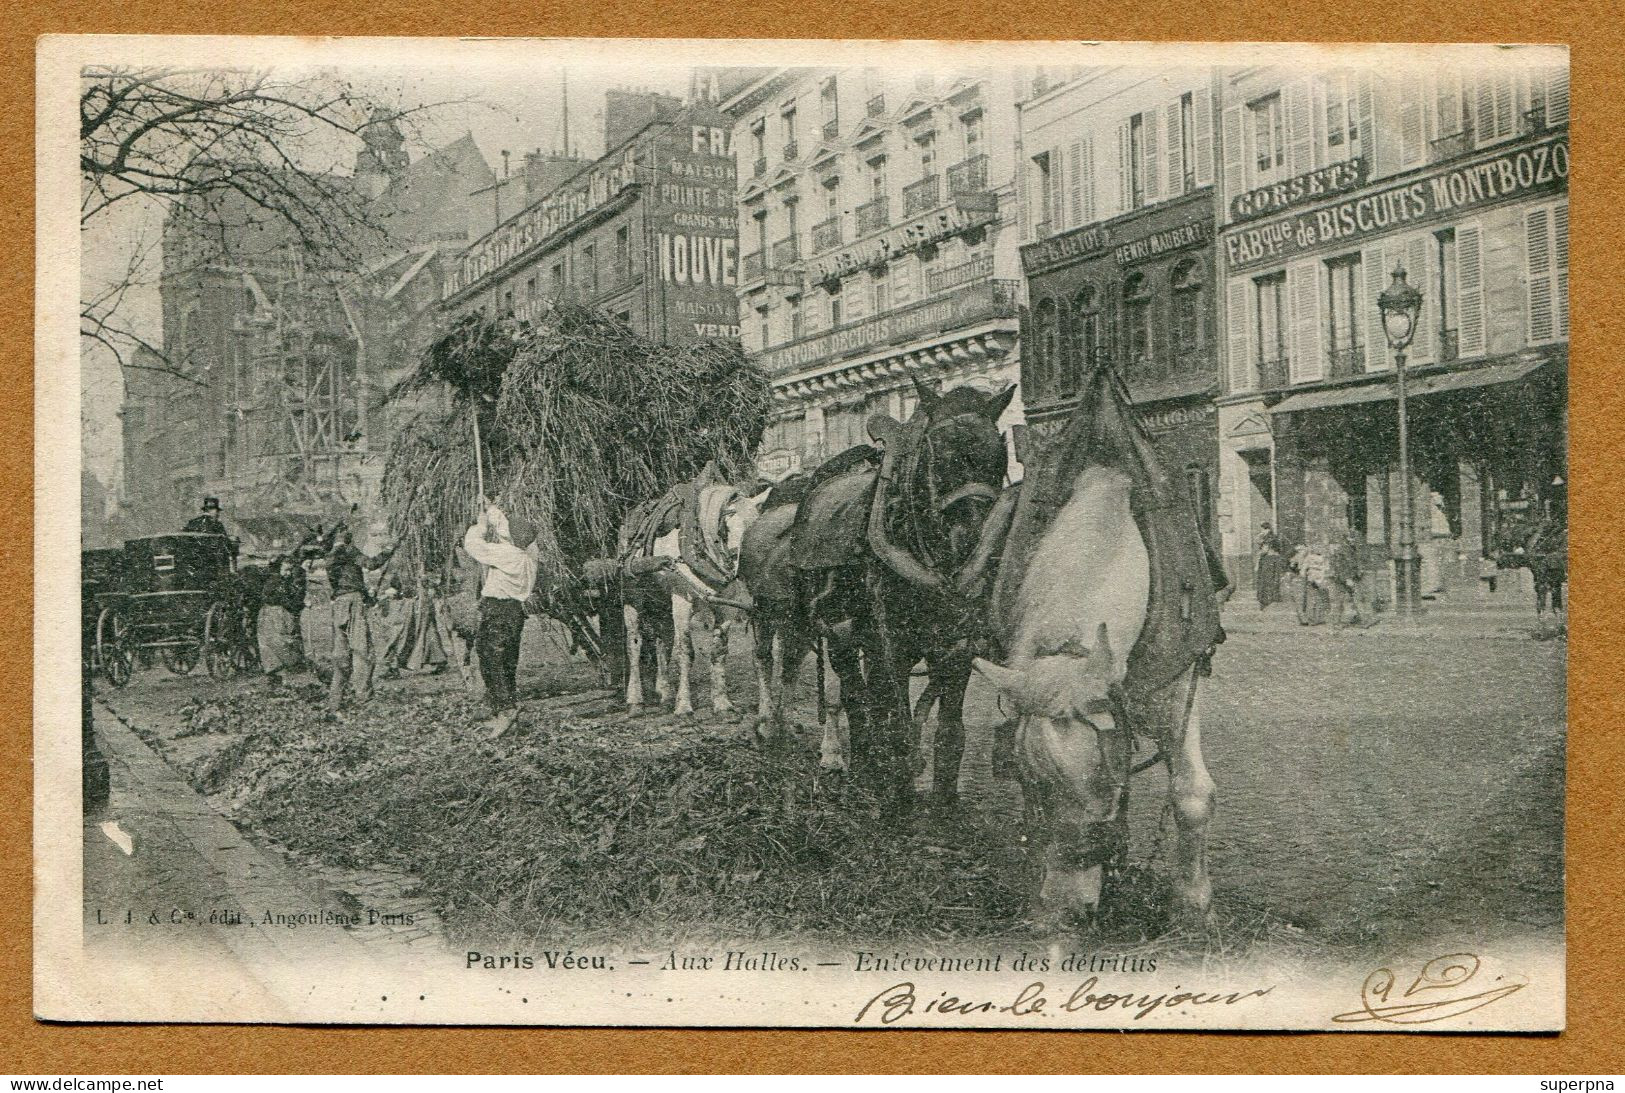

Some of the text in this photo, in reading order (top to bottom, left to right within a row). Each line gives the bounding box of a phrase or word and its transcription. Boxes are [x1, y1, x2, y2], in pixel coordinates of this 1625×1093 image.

[662, 184, 711, 206] POINTE
[1236, 160, 1359, 216] CORSETS
[1297, 218, 1317, 248] de
[1317, 184, 1426, 242] BISCUITS
[1432, 142, 1569, 213] MONTBOZO
[674, 212, 715, 229] GRANDS
[1115, 222, 1201, 265] HENRI MAUBERT
